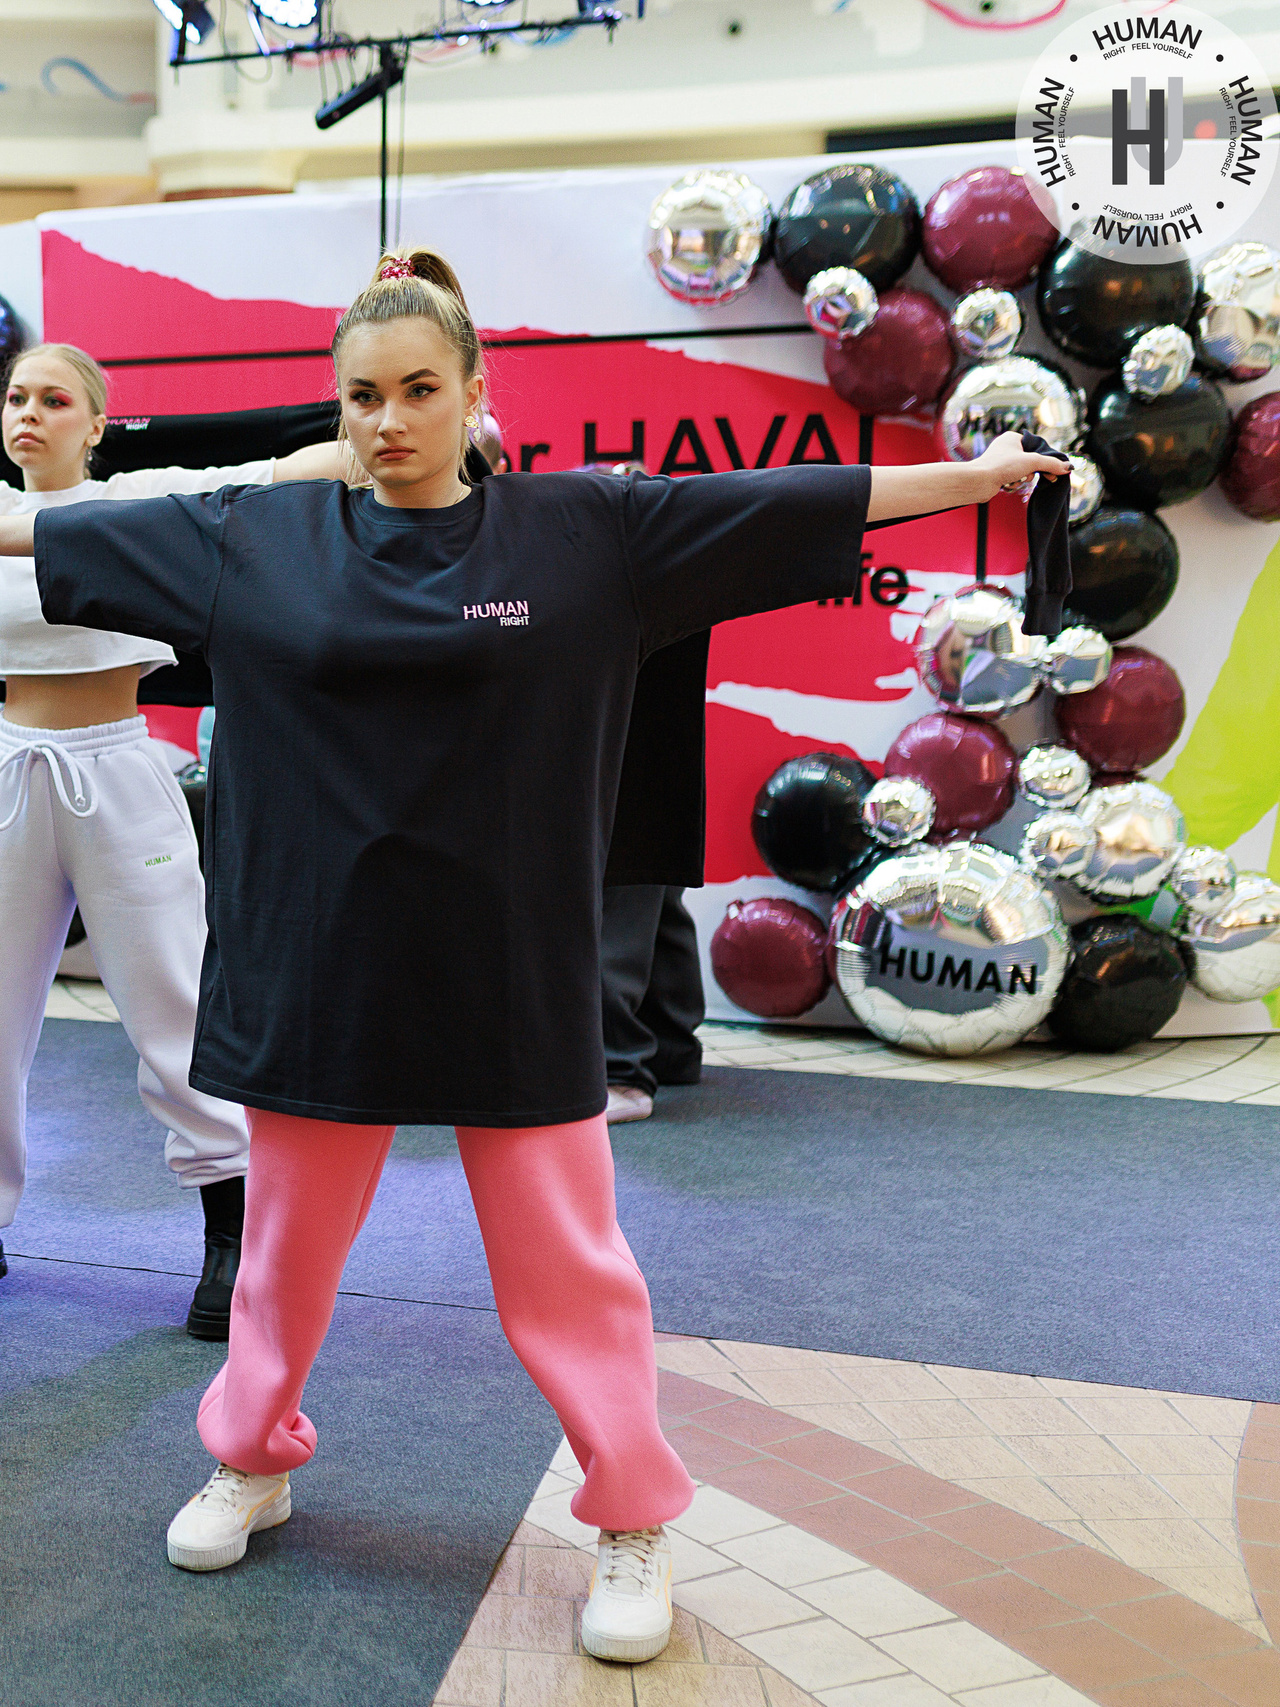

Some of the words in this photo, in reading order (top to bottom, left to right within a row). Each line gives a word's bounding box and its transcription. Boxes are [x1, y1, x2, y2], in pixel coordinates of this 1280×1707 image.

[463, 600, 529, 620] HUMAN
[500, 616, 530, 626] RIGHT
[145, 855, 172, 867] HUMAN
[880, 946, 1038, 995] HUMAN
